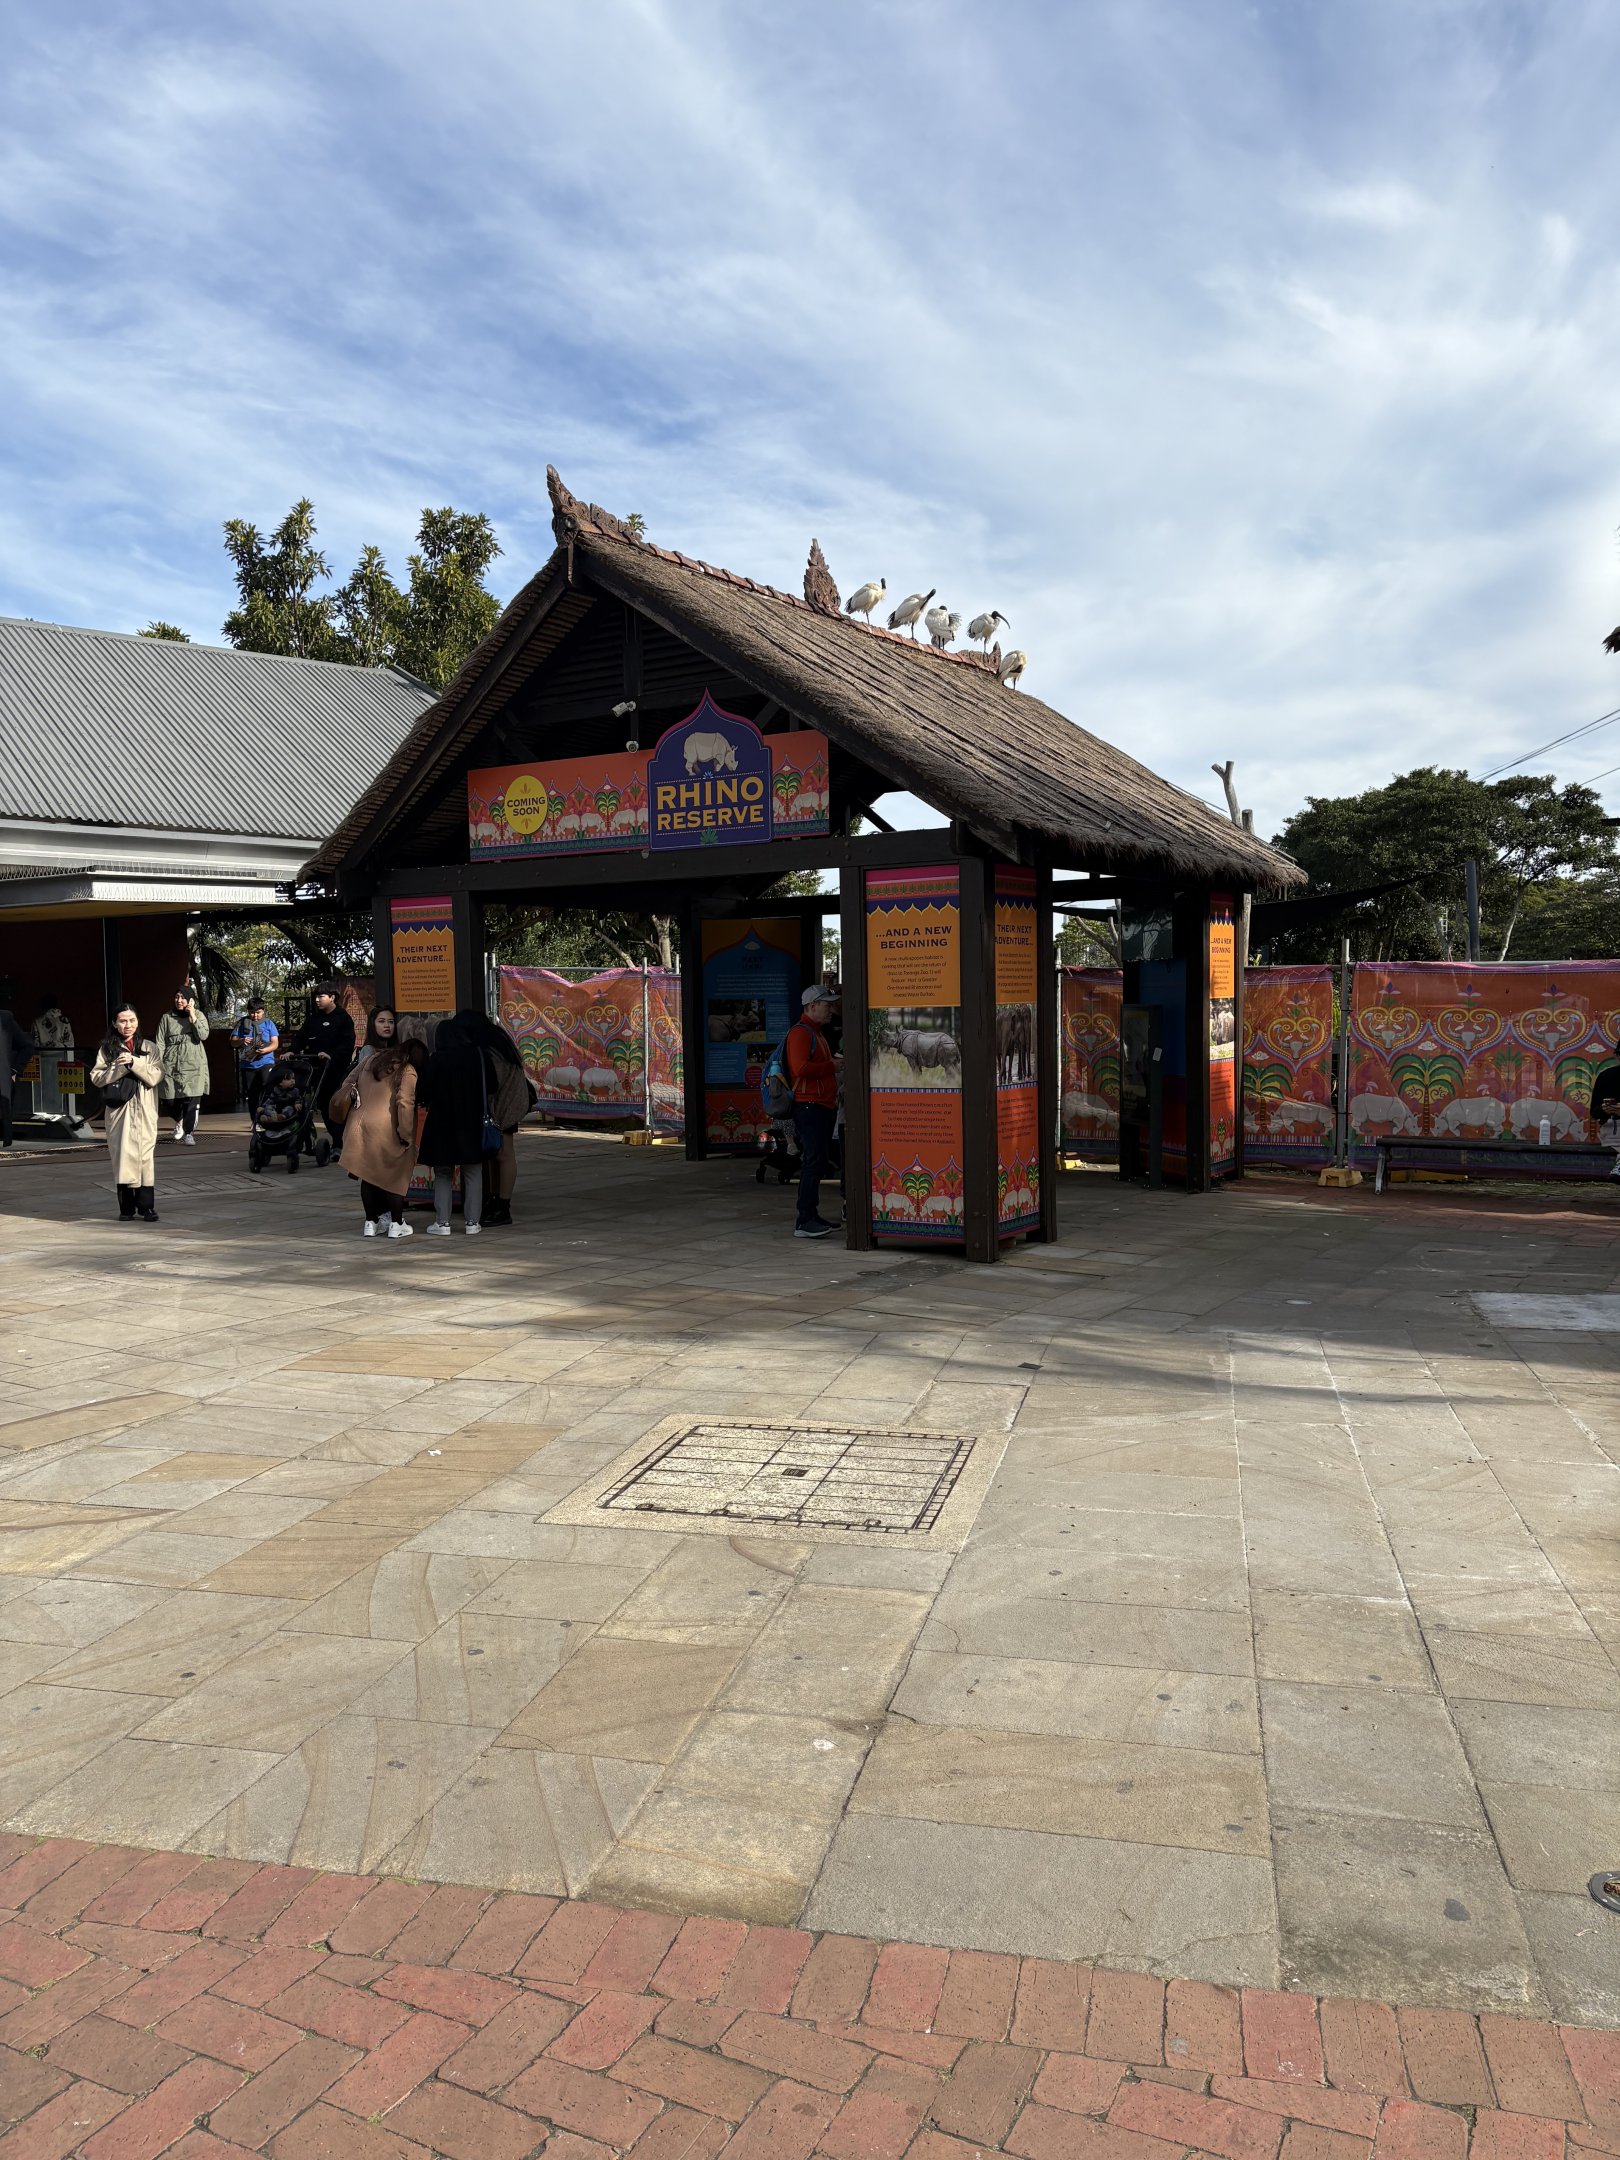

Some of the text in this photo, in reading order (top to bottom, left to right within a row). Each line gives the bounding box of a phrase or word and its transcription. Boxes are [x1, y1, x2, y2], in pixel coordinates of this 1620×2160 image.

[656, 776, 764, 810] RHINO
[507, 796, 546, 808] COMING
[513, 806, 540, 816] SOON
[657, 804, 764, 831] RESERVE
[876, 926, 952, 937] ...AND A NEW
[997, 924, 1032, 934] THEIR NEXT
[400, 944, 448, 954] THEIR NEXT
[881, 938, 948, 949] BEGINNING
[396, 955, 451, 963] ADVENTURE...
